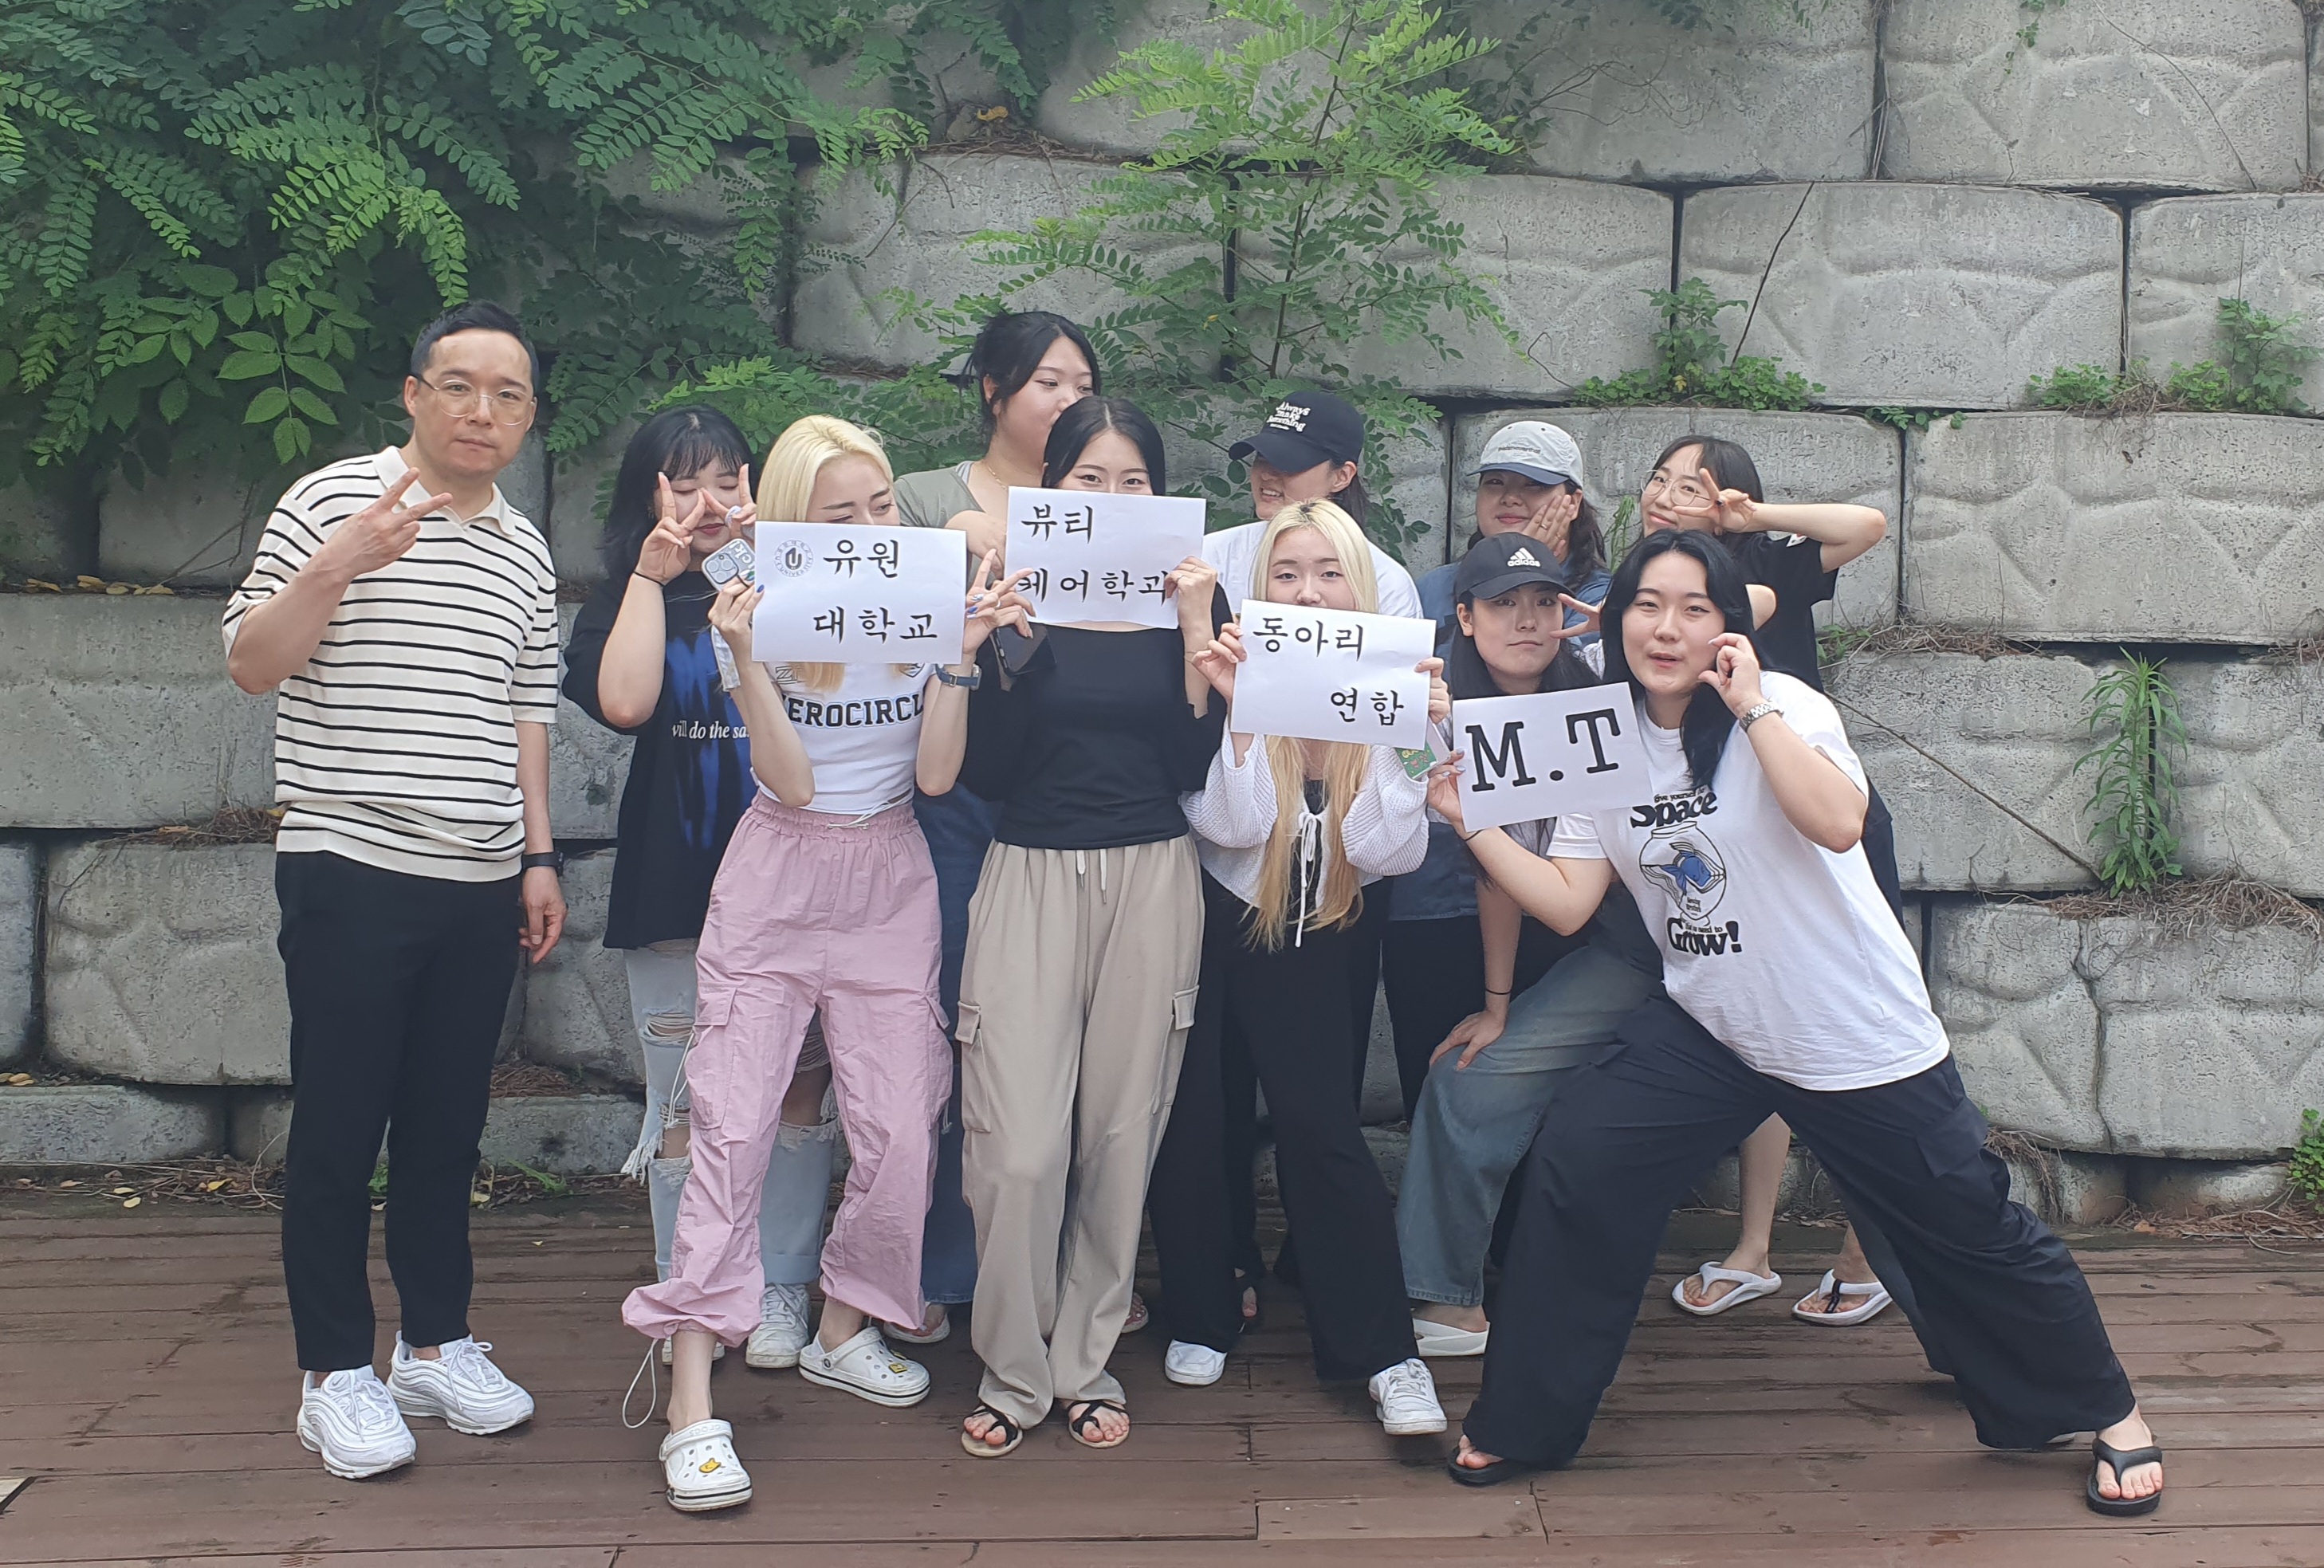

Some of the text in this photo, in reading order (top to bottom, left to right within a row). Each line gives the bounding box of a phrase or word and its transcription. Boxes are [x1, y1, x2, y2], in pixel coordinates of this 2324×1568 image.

[1021, 504, 1093, 544] 뷰티
[823, 539, 899, 578] 유원
[813, 606, 938, 644] 대학교
[1252, 618, 1363, 662] 동아리
[782, 693, 923, 727] EROCIRCL
[1331, 687, 1404, 726] 연합
[689, 721, 706, 739] do
[709, 721, 729, 739] the
[733, 726, 749, 739] sa
[1465, 709, 1621, 792] M.T
